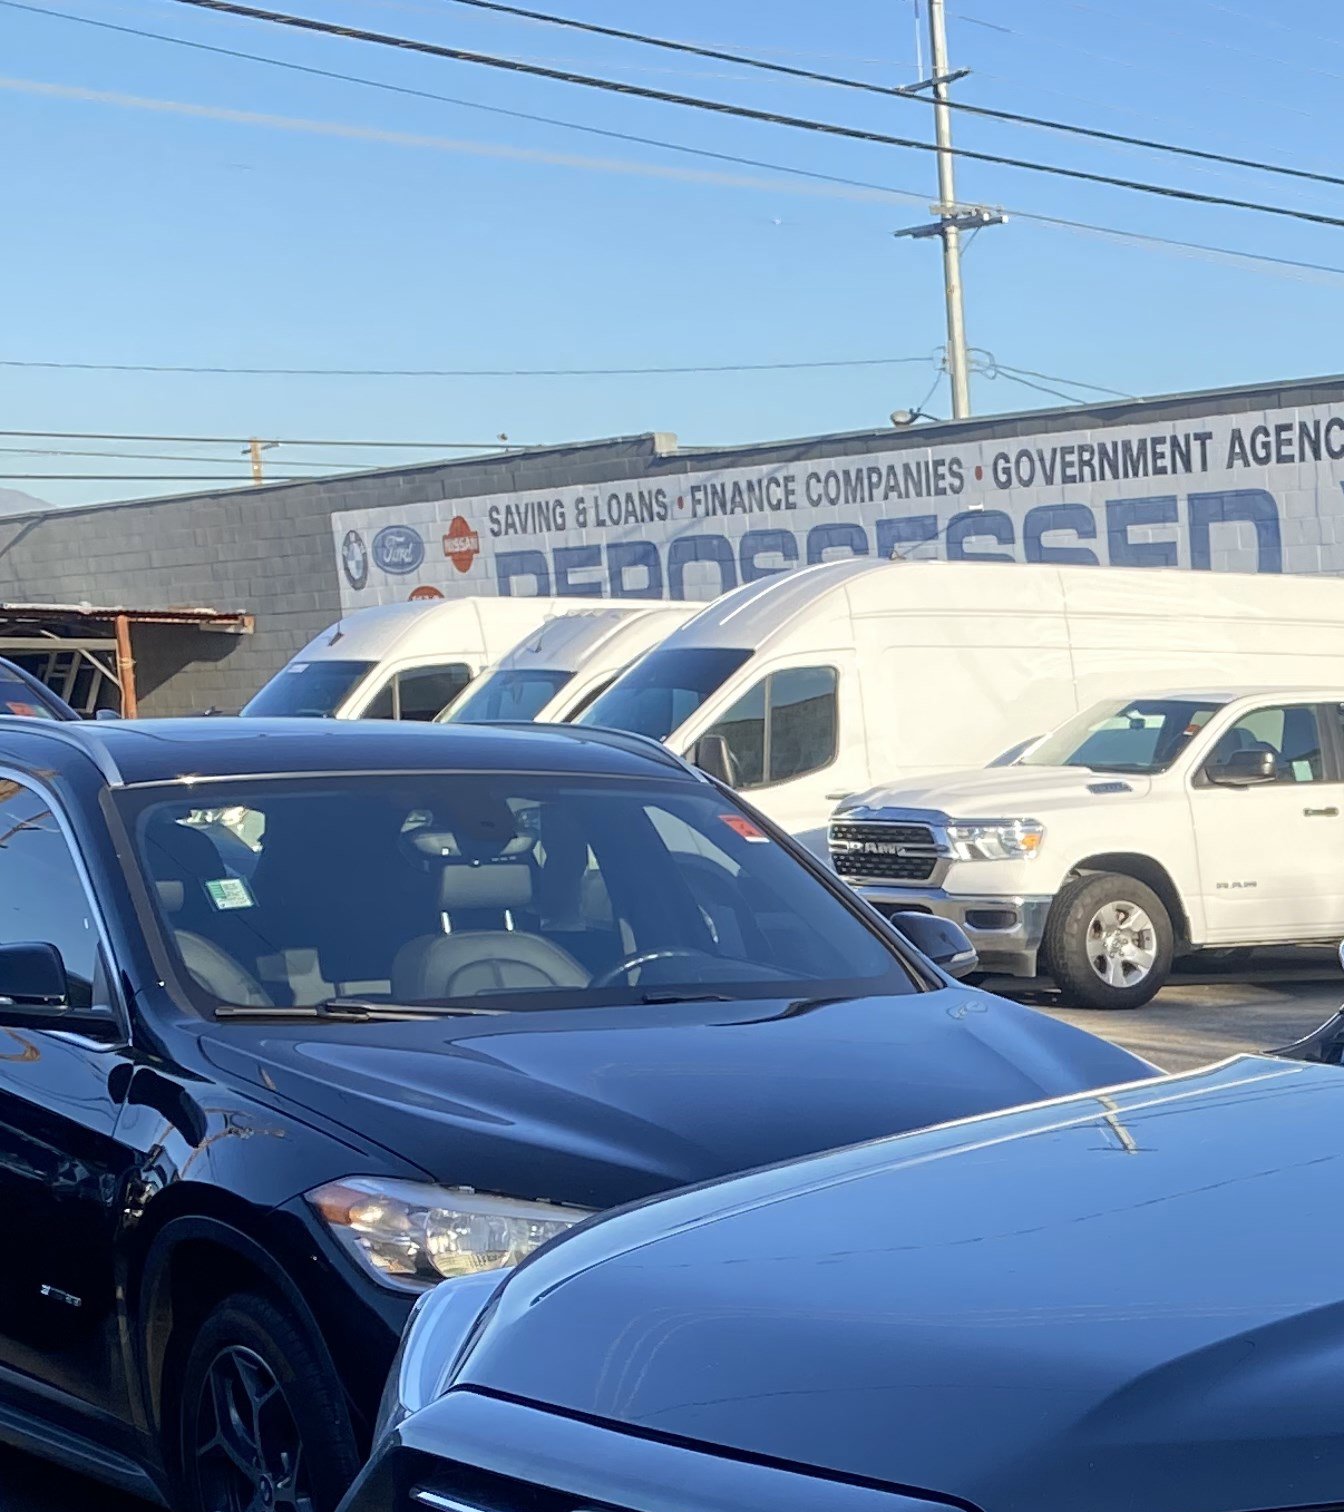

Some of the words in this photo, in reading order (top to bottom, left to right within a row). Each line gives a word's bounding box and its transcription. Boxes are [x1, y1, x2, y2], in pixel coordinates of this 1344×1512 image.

[488, 500, 566, 537] SAVING
[575, 501, 588, 528] &
[594, 488, 669, 526] LOANS
[690, 475, 798, 518] FINANCE
[805, 456, 965, 507] COMPANIES
[992, 431, 1213, 490] GOVERNMENT
